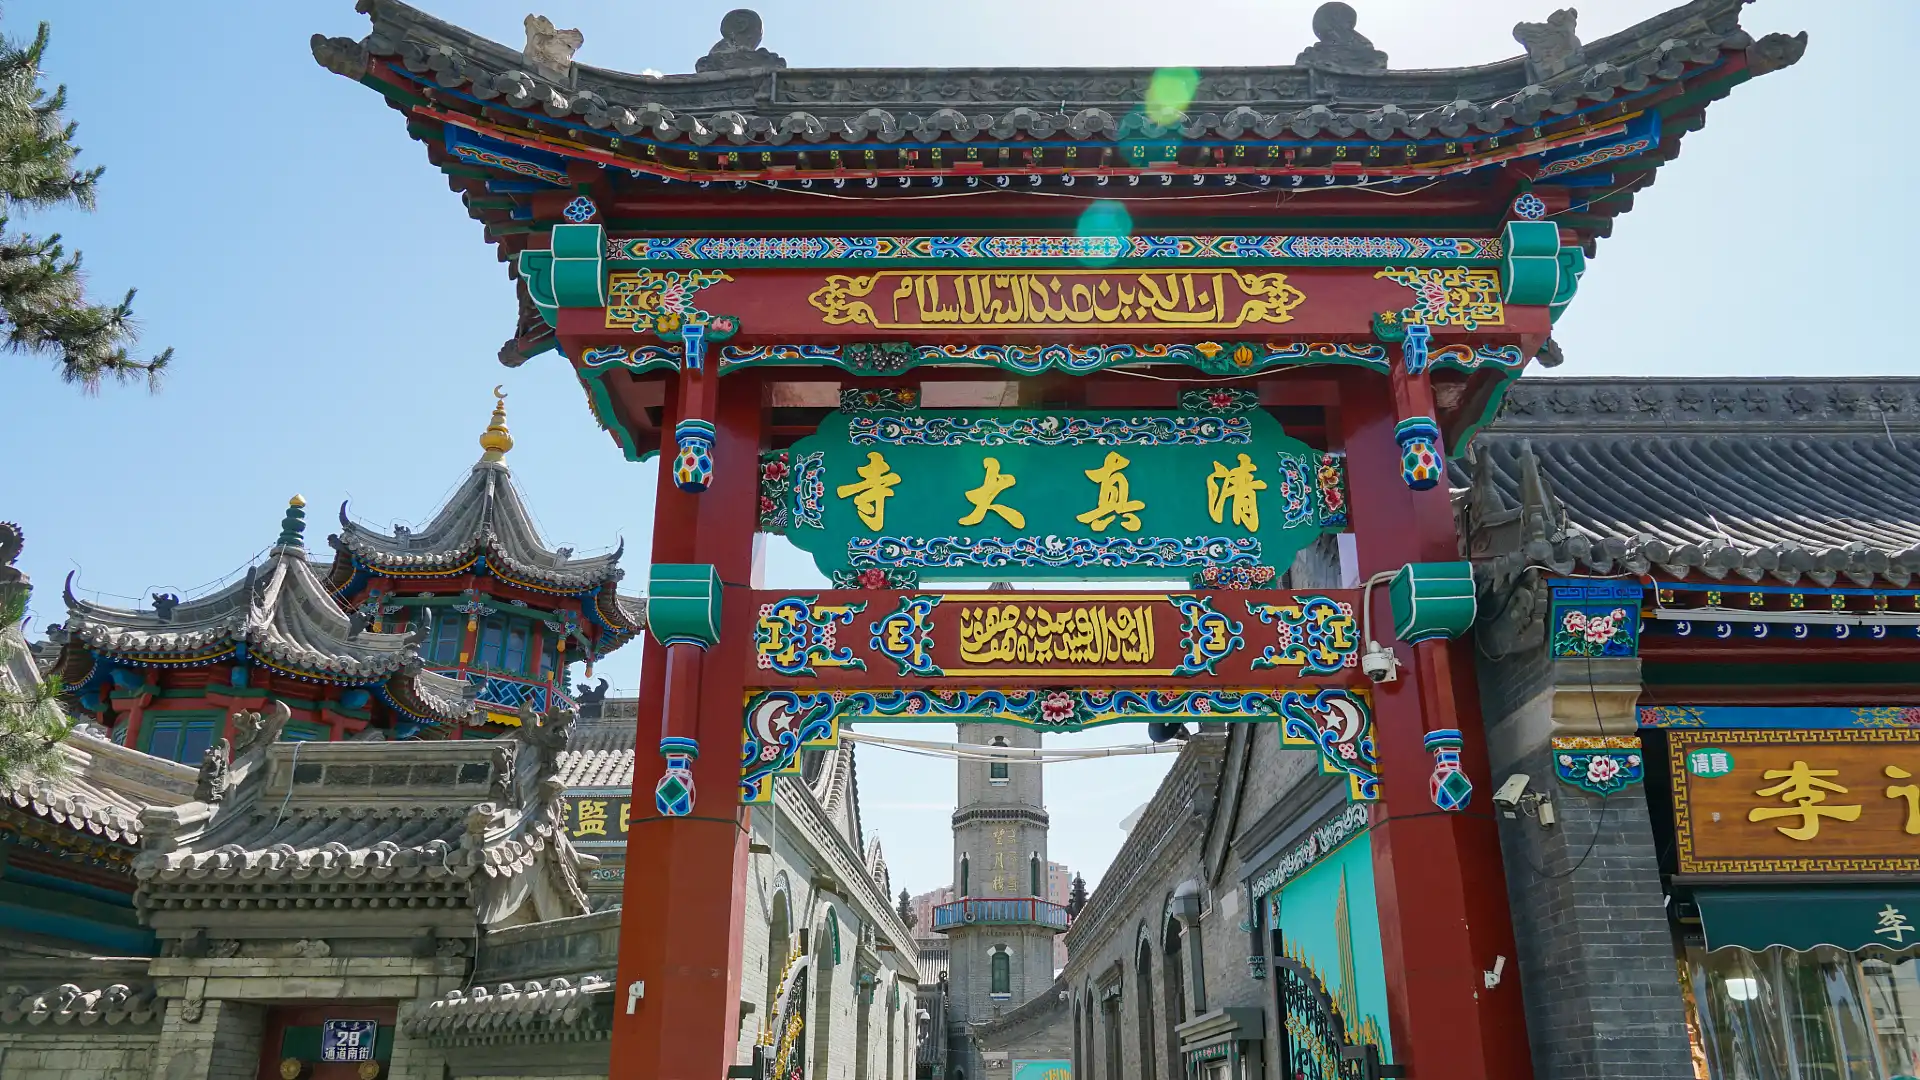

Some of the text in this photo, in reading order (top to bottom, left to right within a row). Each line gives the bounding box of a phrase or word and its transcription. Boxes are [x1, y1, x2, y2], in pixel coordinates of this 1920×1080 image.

[1692, 753, 1729, 773] 清真
[1874, 903, 1916, 943] 李
[336, 1031, 360, 1047] 28
[325, 1046, 370, 1060] 通道南街
